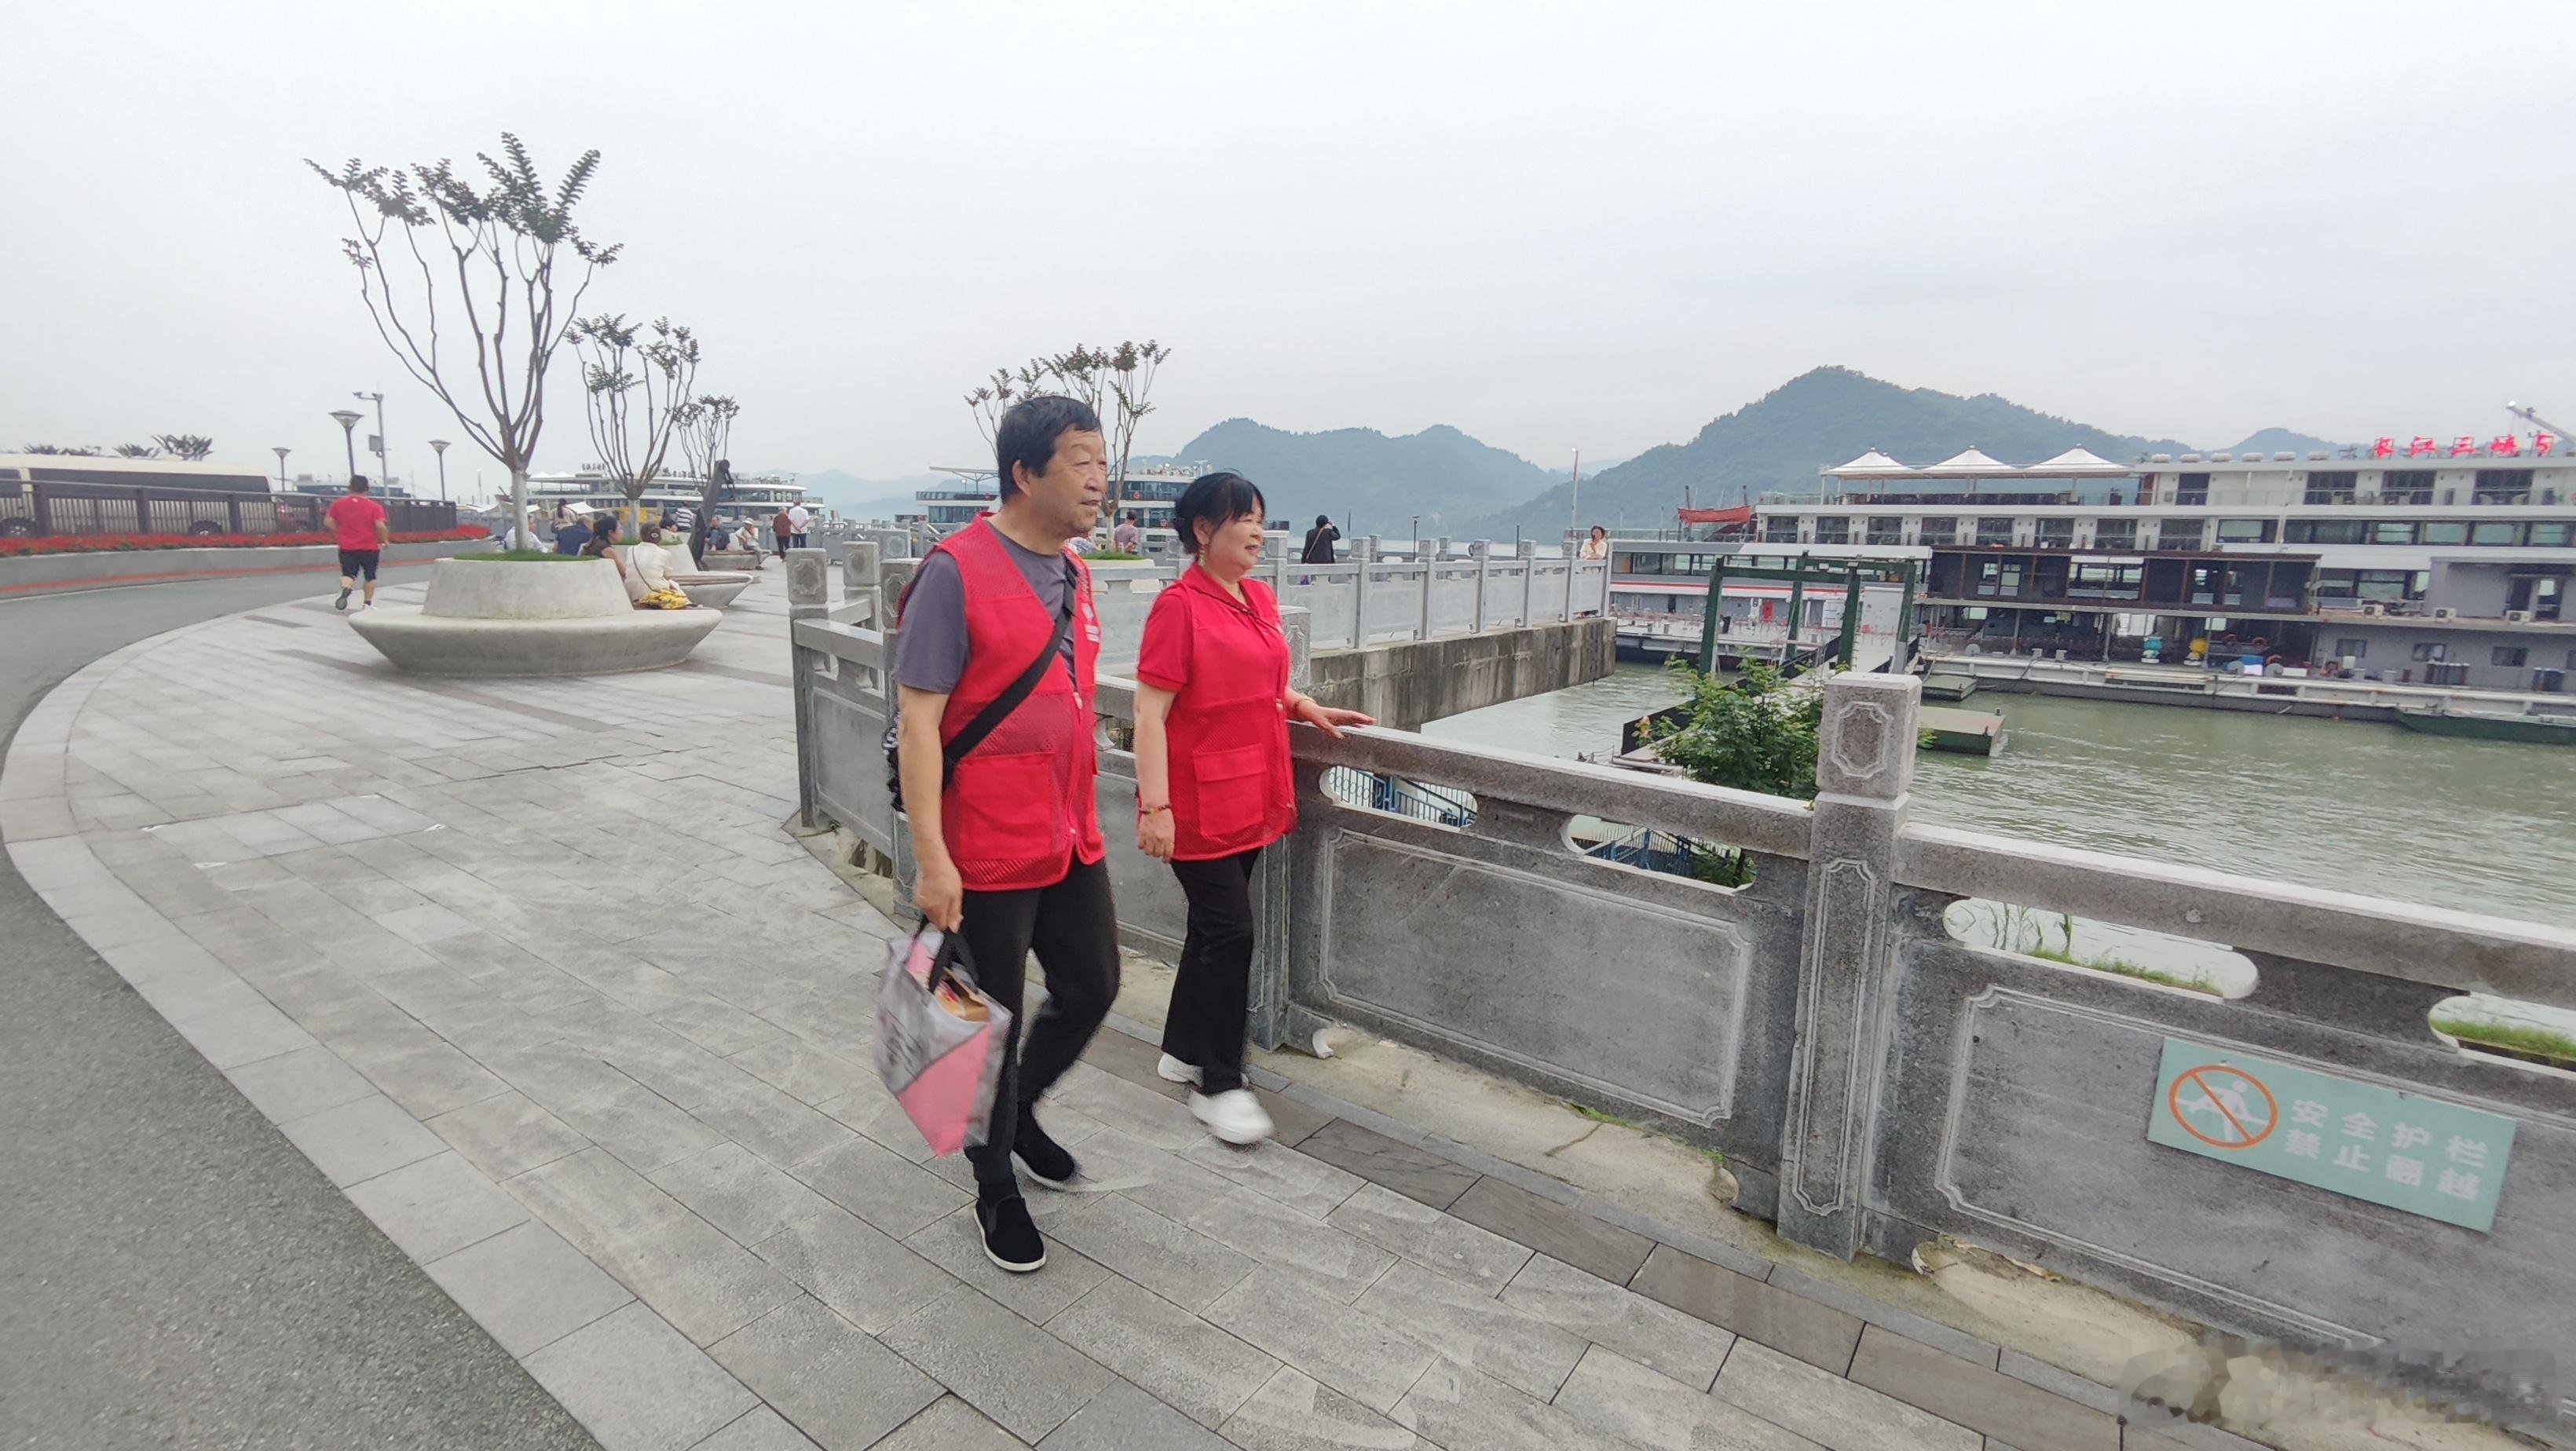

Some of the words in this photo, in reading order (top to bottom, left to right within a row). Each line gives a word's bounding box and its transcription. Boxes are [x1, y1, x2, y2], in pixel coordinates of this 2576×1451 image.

[2285, 1128, 2480, 1201] 禁止翻越
[2291, 1099, 2488, 1168] 安全护栏
